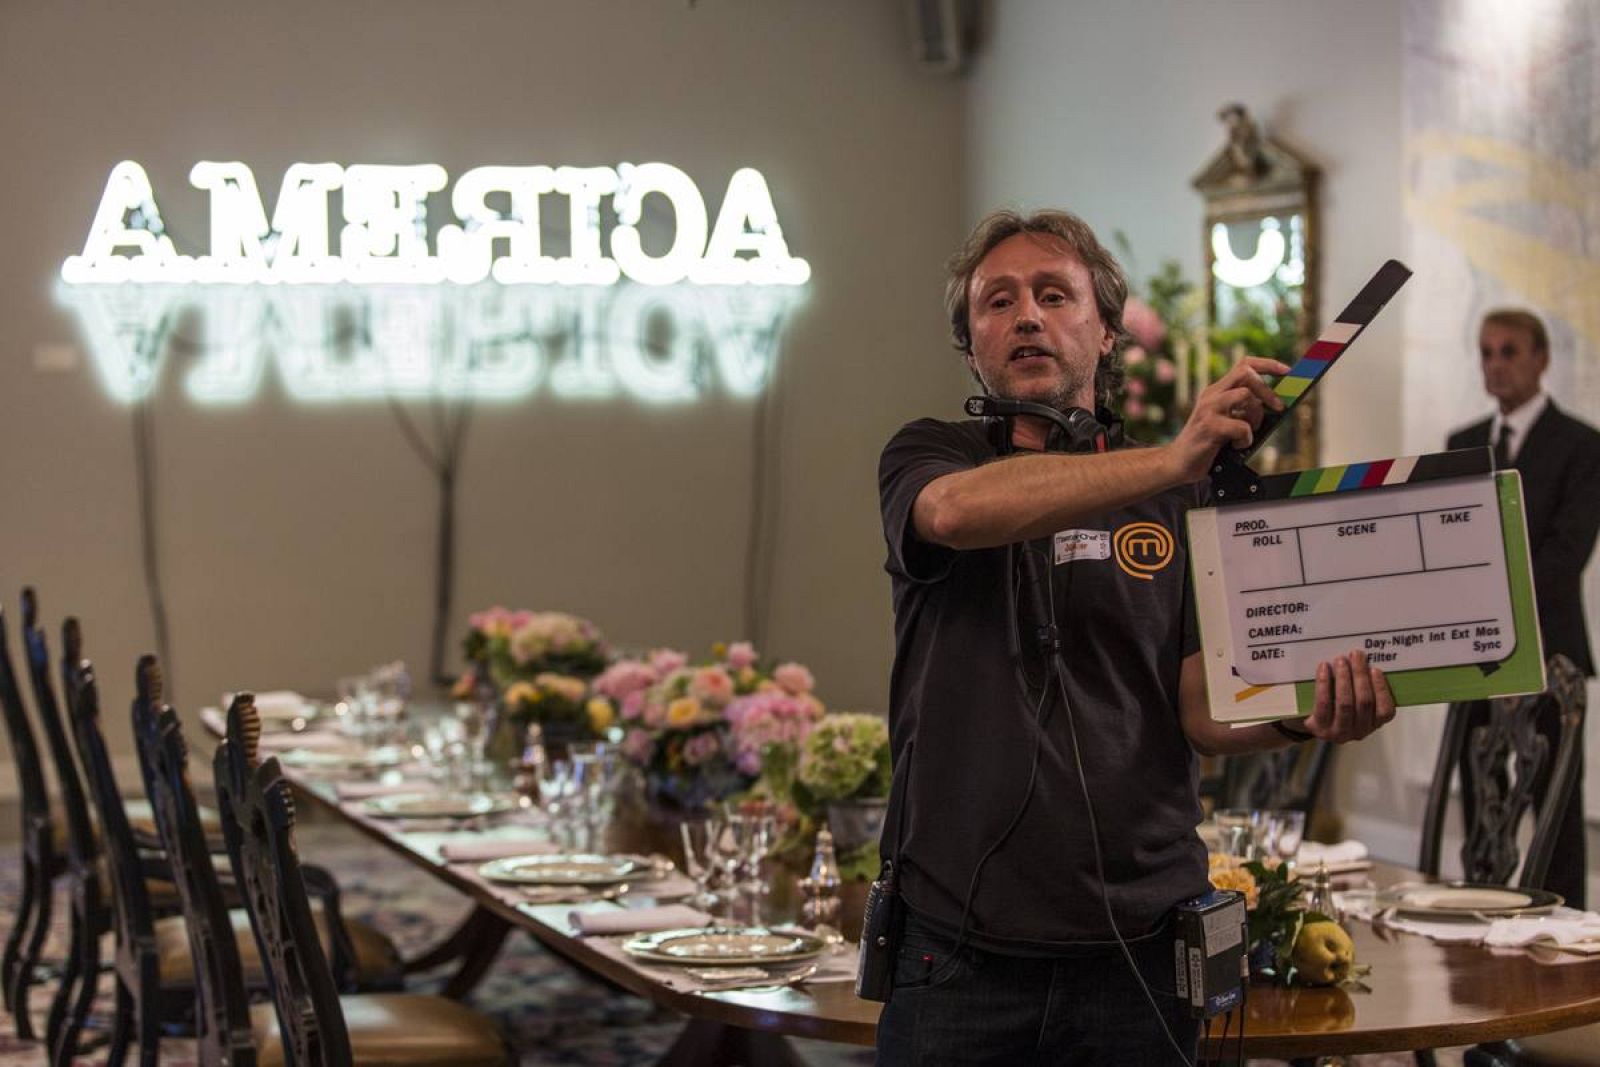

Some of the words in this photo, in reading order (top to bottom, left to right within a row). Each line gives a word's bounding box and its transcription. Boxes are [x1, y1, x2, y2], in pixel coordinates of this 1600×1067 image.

[60, 160, 811, 285] AMERICA
[1439, 511, 1472, 524] TAKE
[1235, 519, 1269, 532] PROD.
[1337, 522, 1377, 537] SCENE
[1252, 534, 1282, 547] ROLL
[1246, 602, 1309, 618] DIRECTOR:
[1248, 623, 1302, 639] CAMERA:
[1364, 634, 1424, 650] Day-Night
[1429, 631, 1446, 642] Int
[1451, 628, 1470, 640] Ext
[1475, 625, 1500, 637] Mos
[1251, 647, 1285, 661] DATE:
[1367, 652, 1397, 664] Filter
[1473, 640, 1502, 653] Sync
